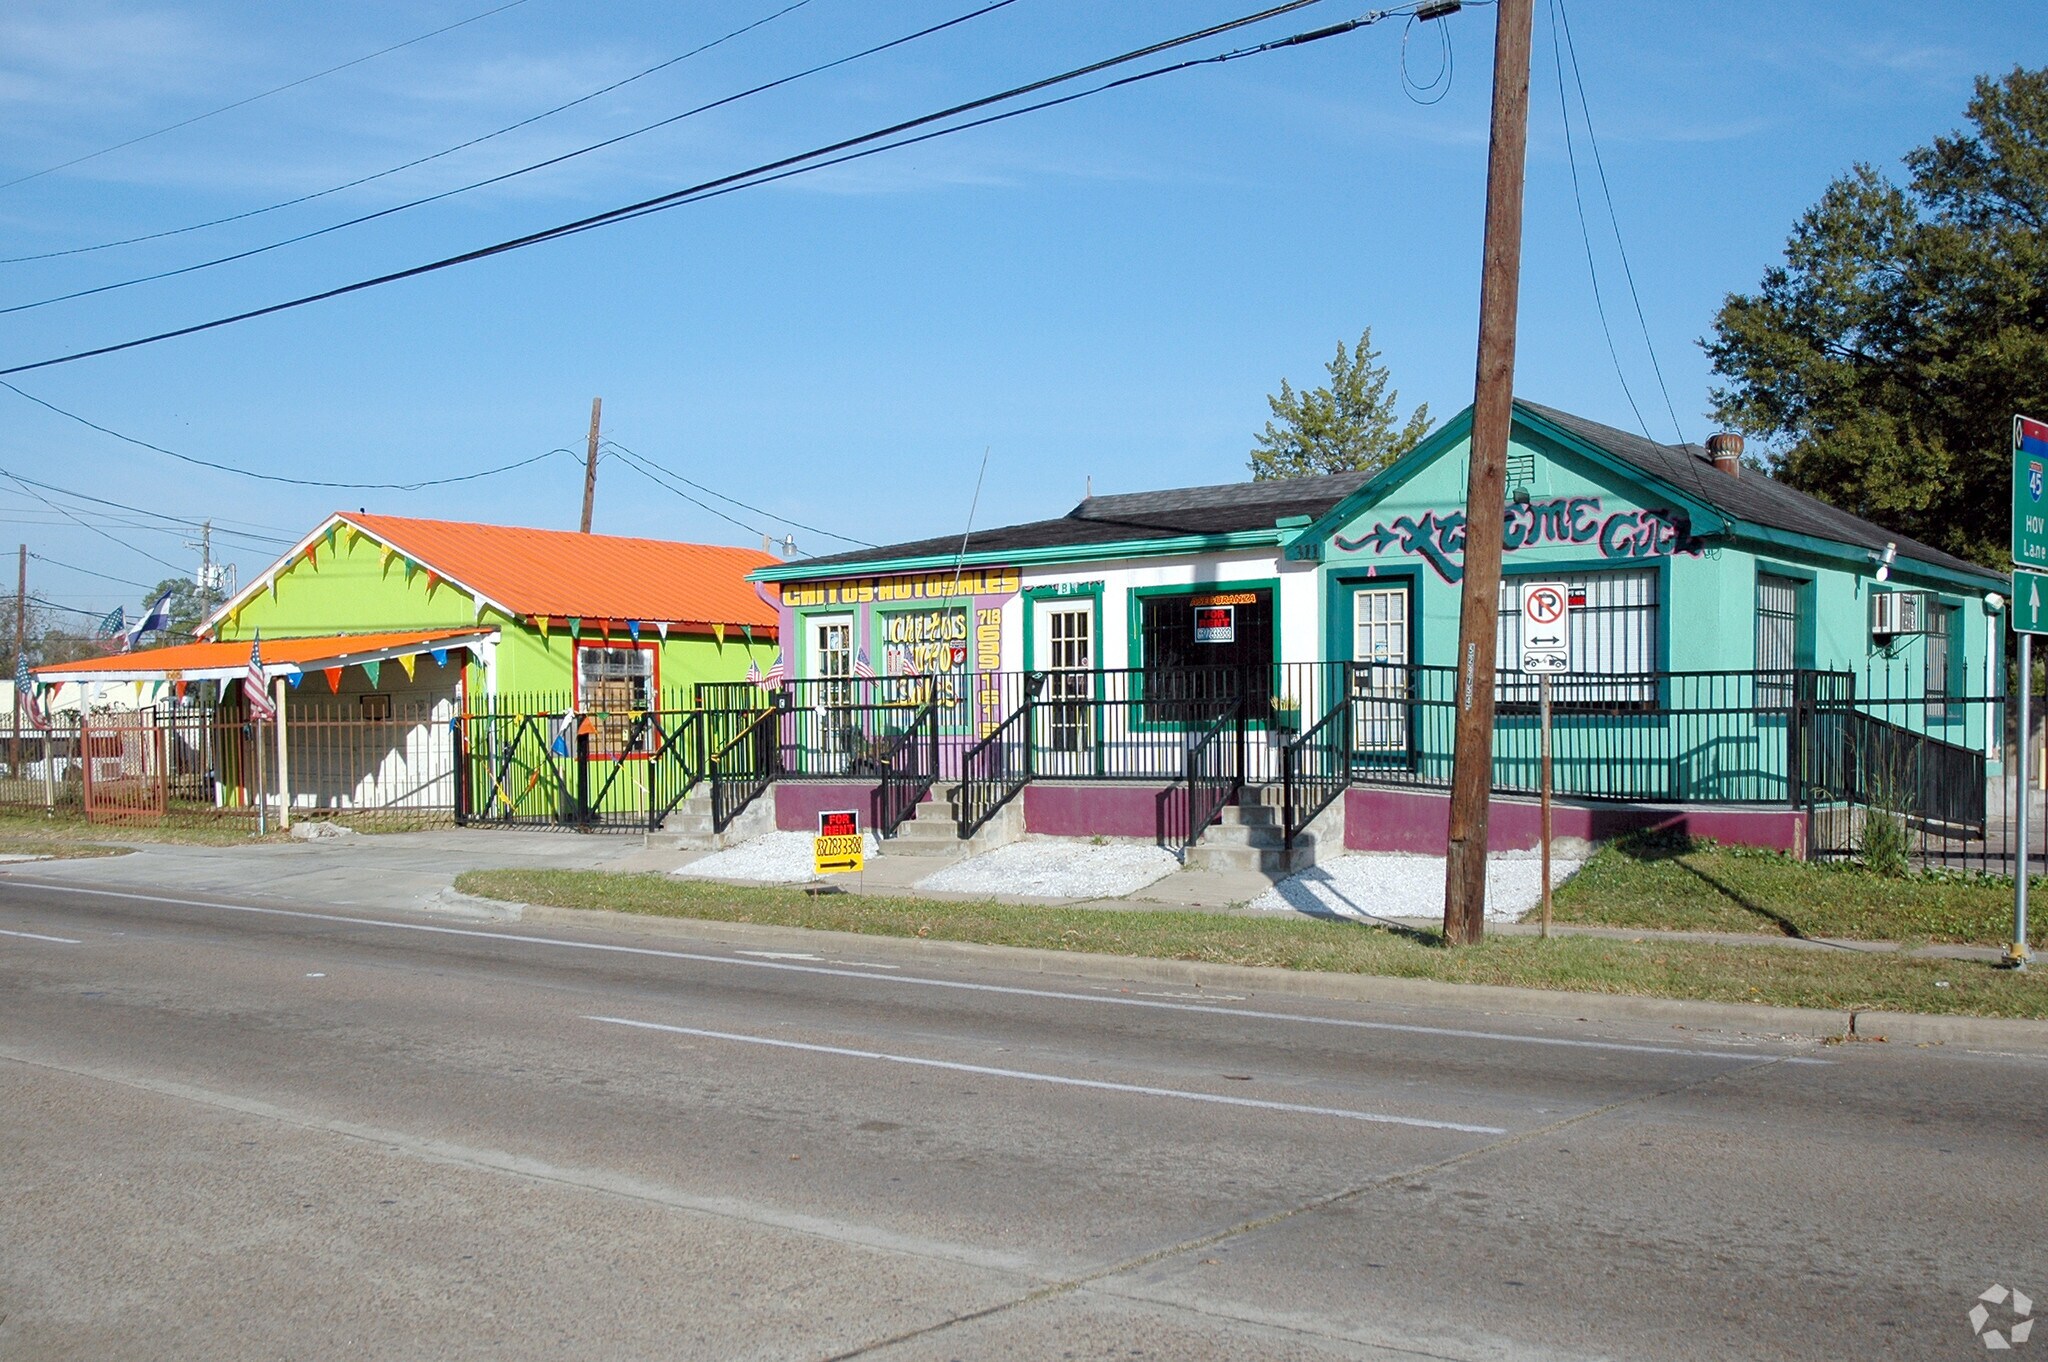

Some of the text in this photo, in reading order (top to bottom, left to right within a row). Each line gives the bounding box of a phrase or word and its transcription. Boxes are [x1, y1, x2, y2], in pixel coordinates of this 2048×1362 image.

[2029, 473, 2042, 495] 45
[2026, 515, 2044, 534] HOV
[2024, 539, 2046, 559] Lane
[1366, 564, 1377, 578] A
[782, 578, 874, 607] CHITOS
[1538, 593, 1557, 617] P
[1204, 609, 1225, 619] FOR
[1199, 618, 1230, 629] RENT
[829, 815, 849, 824] FOR
[824, 825, 855, 836] RENT
